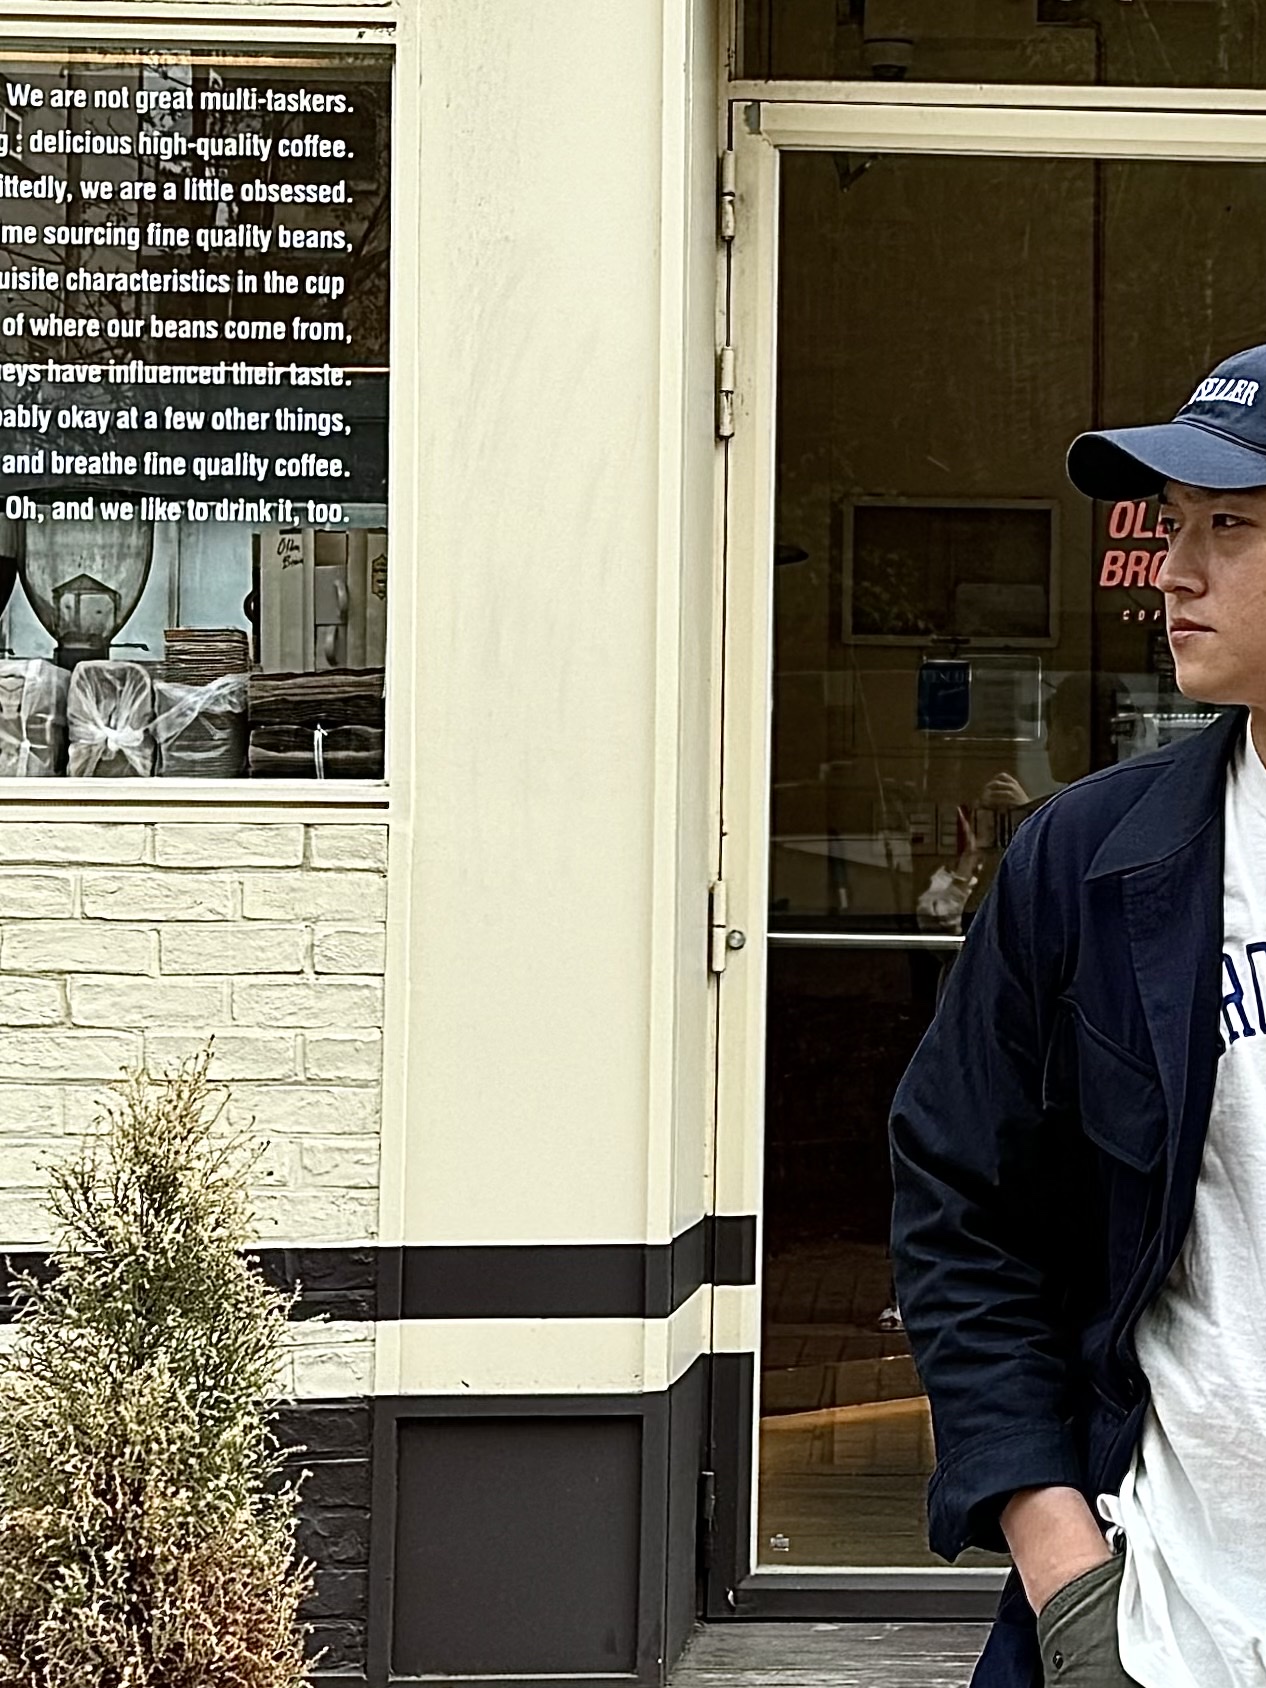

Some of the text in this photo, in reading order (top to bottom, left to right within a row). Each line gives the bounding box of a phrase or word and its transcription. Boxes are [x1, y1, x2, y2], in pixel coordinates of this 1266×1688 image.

[6, 82, 354, 113] We are not great multi-taskers.
[30, 130, 132, 154] delicious
[139, 131, 272, 161] high-quality
[278, 134, 354, 158] coffee.
[80, 181, 113, 199] we
[120, 181, 156, 200] are
[163, 181, 177, 200] a
[185, 177, 234, 201] little
[241, 178, 354, 203] obsessed.
[43, 222, 140, 250] sourcing
[147, 223, 190, 246] fine
[196, 224, 272, 252] quality
[278, 224, 352, 252] beans,
[66, 267, 230, 293] characteristics
[237, 270, 258, 293] in
[264, 270, 298, 294] the
[305, 275, 344, 300] cup
[3, 313, 352, 344] of where our beans come from,
[47, 359, 101, 383] have
[109, 360, 225, 384] influenced
[232, 361, 281, 385] their
[290, 363, 352, 386] taste.
[1190, 377, 1259, 407] SELLER
[58, 405, 110, 434] okay
[116, 407, 138, 429] at
[144, 411, 157, 429] a
[164, 406, 205, 430] few
[211, 407, 270, 430] other
[275, 408, 351, 436] things,
[2, 450, 351, 481] and breathe fine quality coffee.
[6, 496, 350, 526] Oh, and we like to drink it, too.
